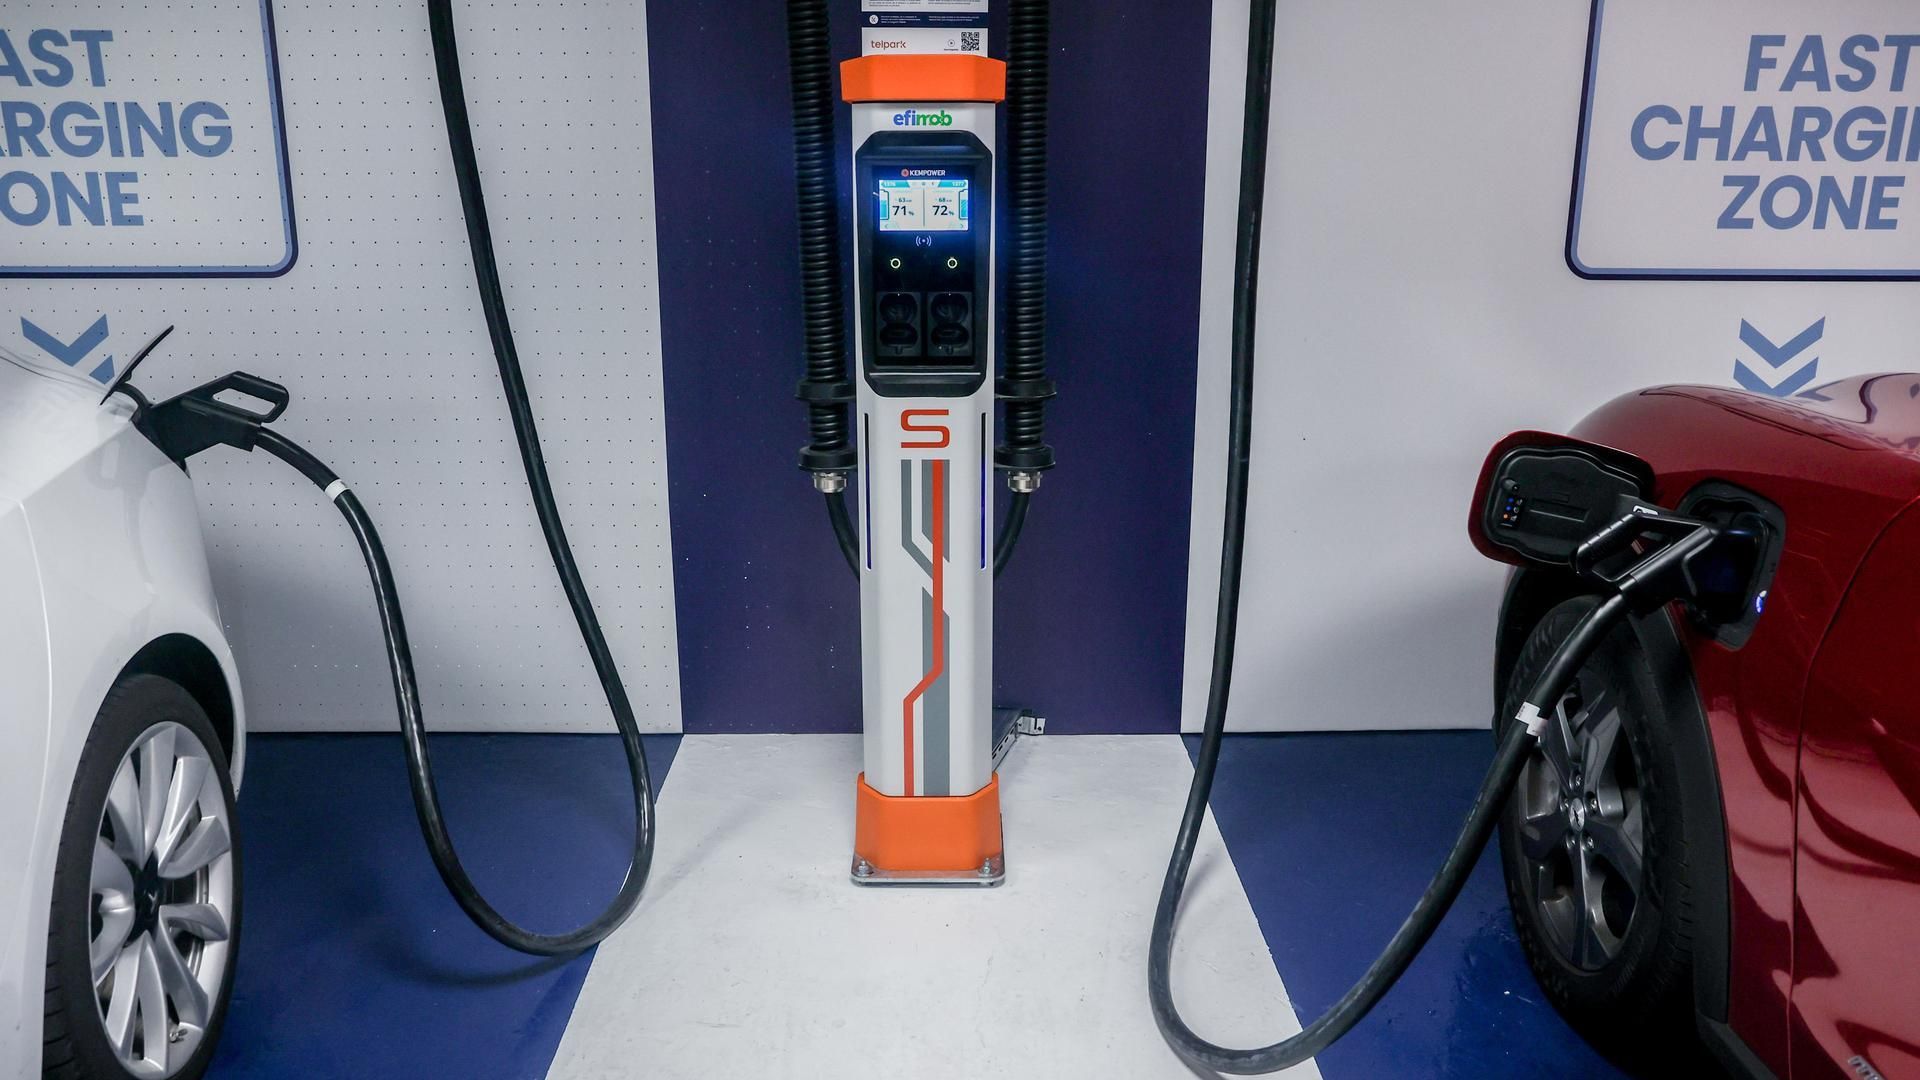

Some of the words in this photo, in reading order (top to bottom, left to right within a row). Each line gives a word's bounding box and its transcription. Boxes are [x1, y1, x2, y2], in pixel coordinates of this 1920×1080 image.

[870, 39, 907, 50] telpark
[1743, 34, 1920, 92] FAST
[0, 101, 233, 158] RGING
[893, 109, 953, 126] efimob
[1630, 104, 1920, 162] CHARGI
[909, 169, 946, 177] KEMPOWER
[1716, 174, 1906, 230] ZONE
[900, 408, 951, 448] S
